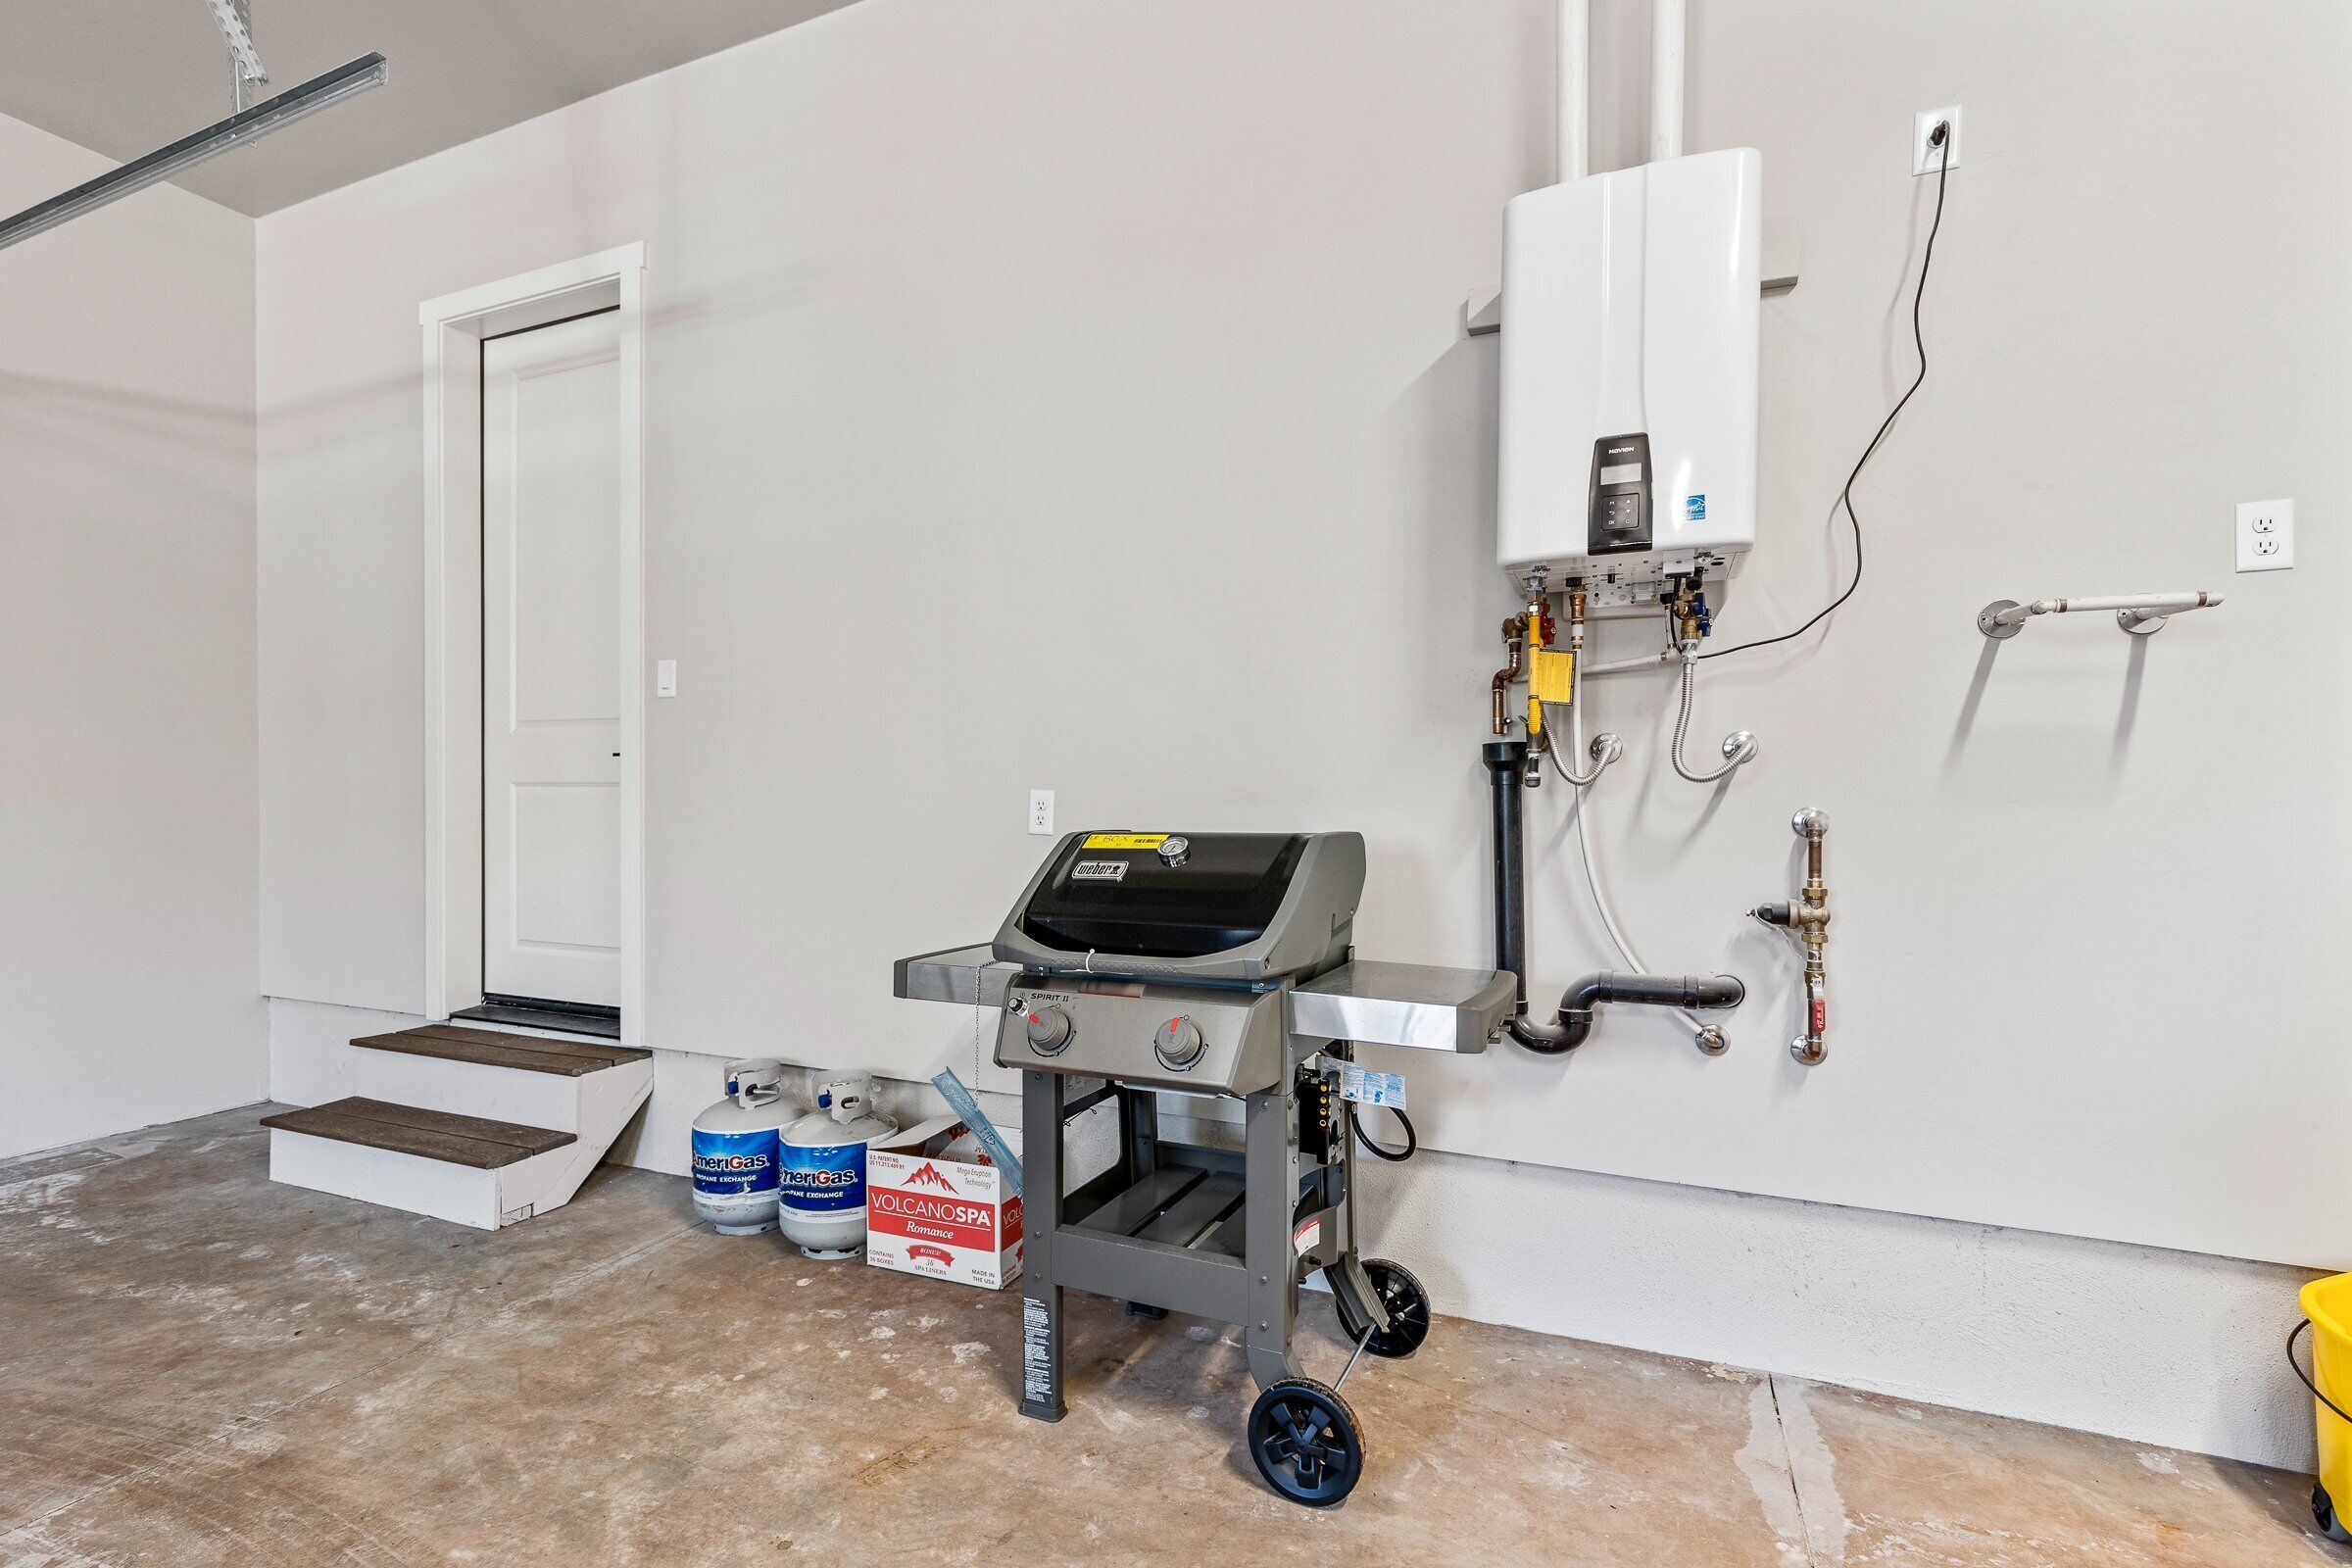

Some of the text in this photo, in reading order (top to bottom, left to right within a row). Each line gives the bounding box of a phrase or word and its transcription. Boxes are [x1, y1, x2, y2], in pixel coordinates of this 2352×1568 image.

[1077, 861, 1112, 875] weber
[1030, 993, 1060, 1002] SPIRIT
[956, 1166, 970, 1176] Mega
[719, 1174, 758, 1183] EXCHANGE
[906, 1220, 955, 1240] Romance
[869, 1249, 895, 1259] CONTAINS
[925, 1258, 935, 1267] 36
[925, 1267, 948, 1276] LINERS
